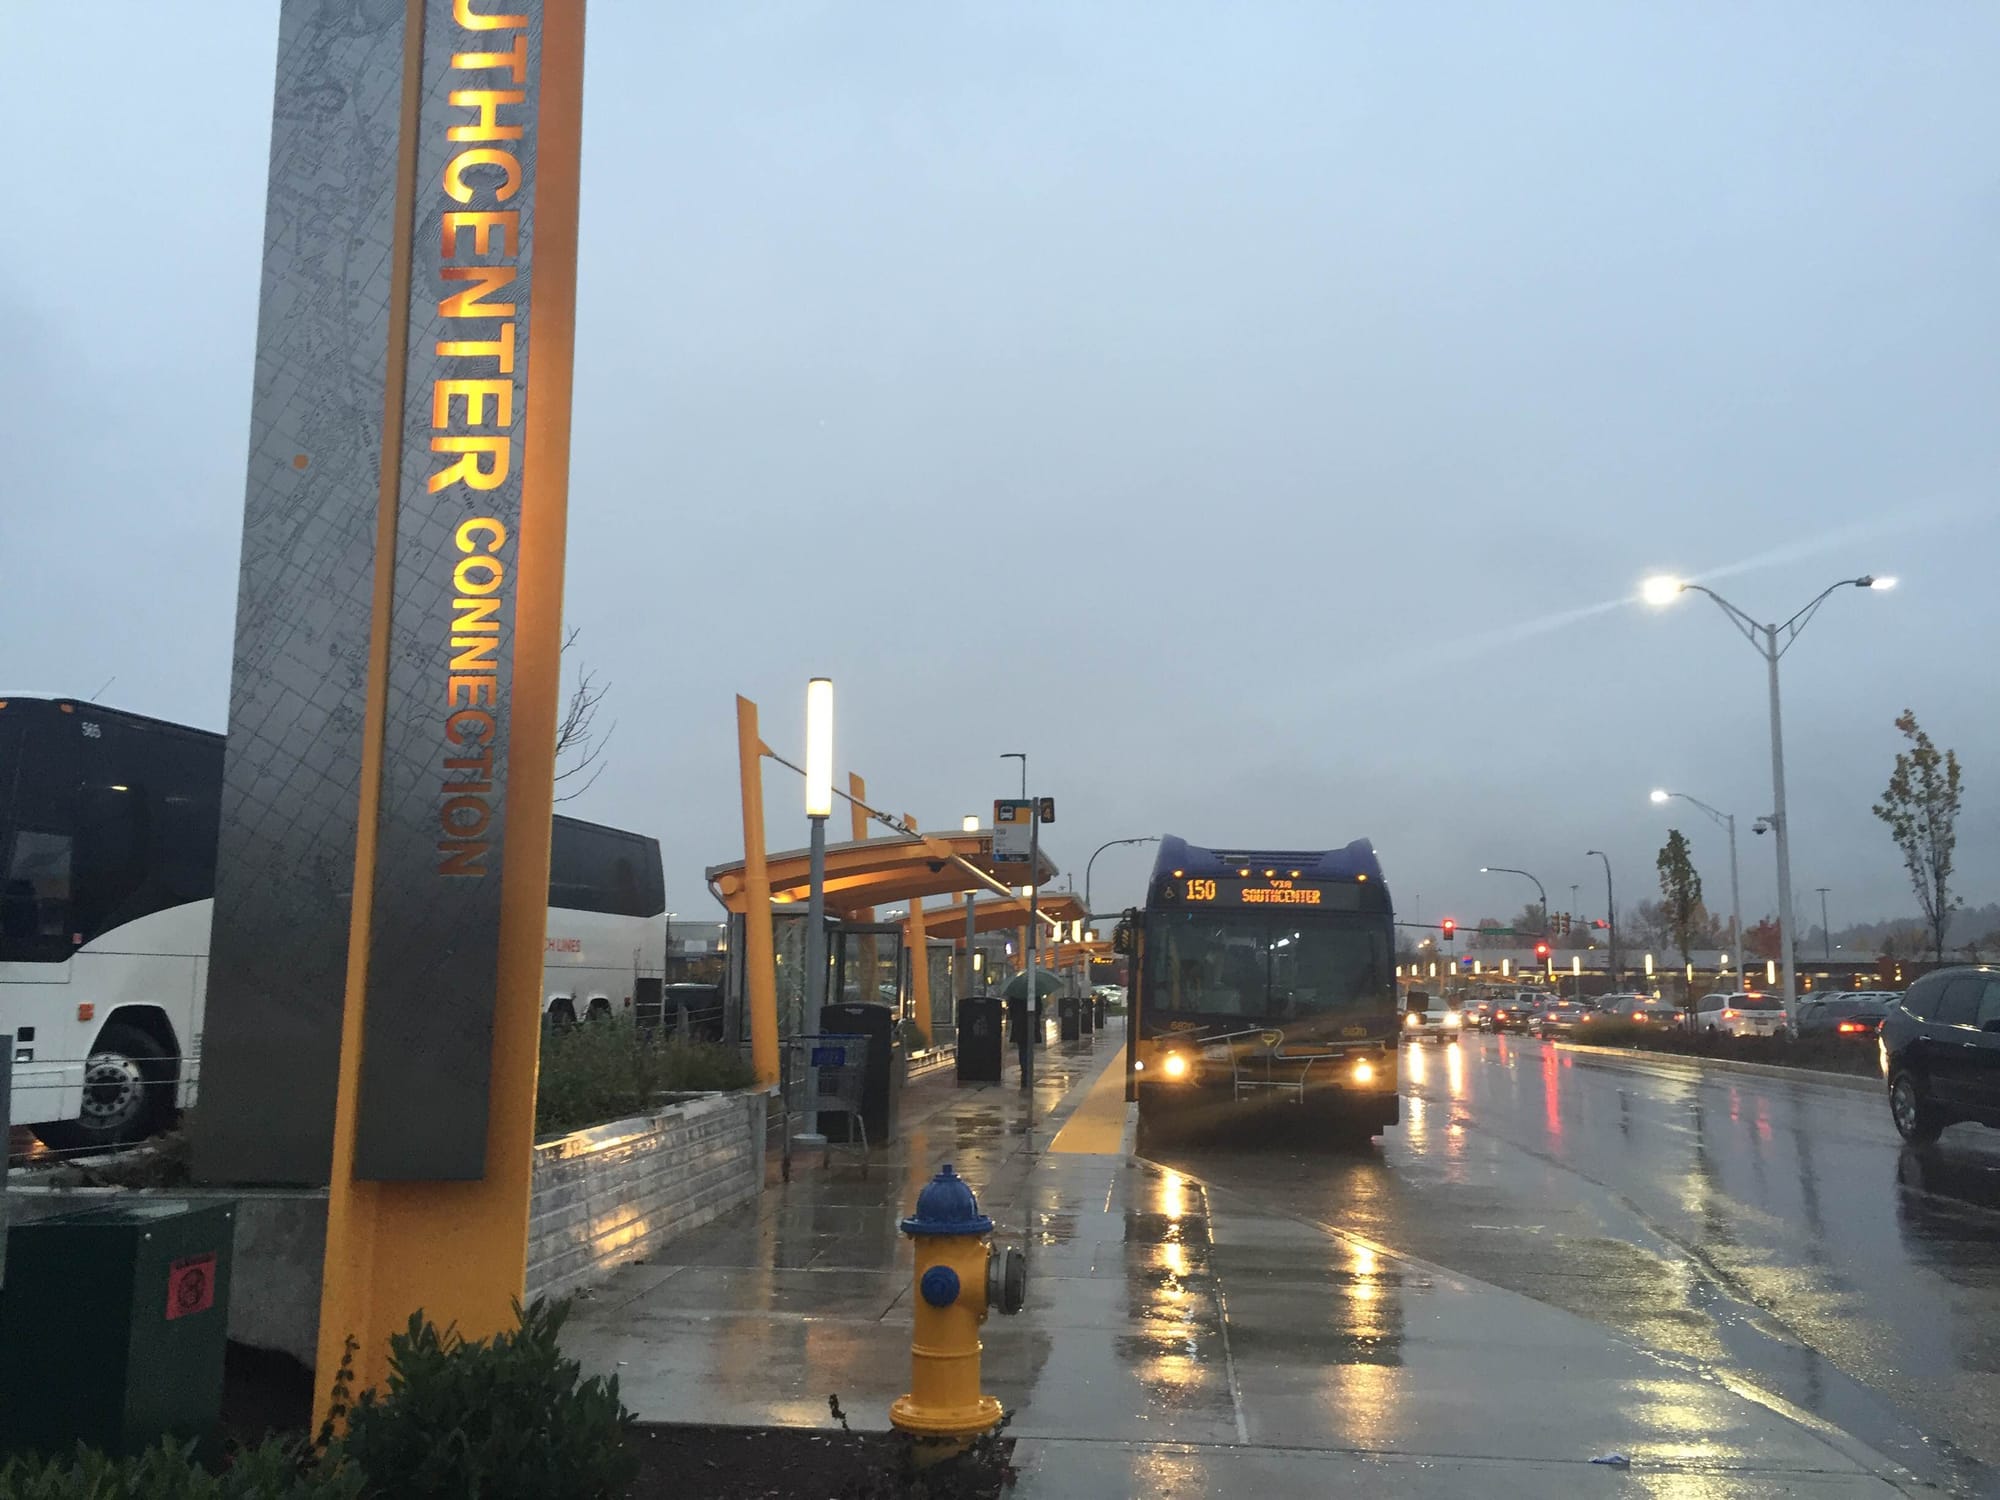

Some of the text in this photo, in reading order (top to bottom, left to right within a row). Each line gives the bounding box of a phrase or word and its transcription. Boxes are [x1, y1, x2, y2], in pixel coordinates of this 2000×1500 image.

[438, 517, 506, 876] CONNECTION
[1186, 879, 1216, 900] 150
[1269, 880, 1293, 888] VIA
[1241, 888, 1320, 903] SOUTHCENTER
